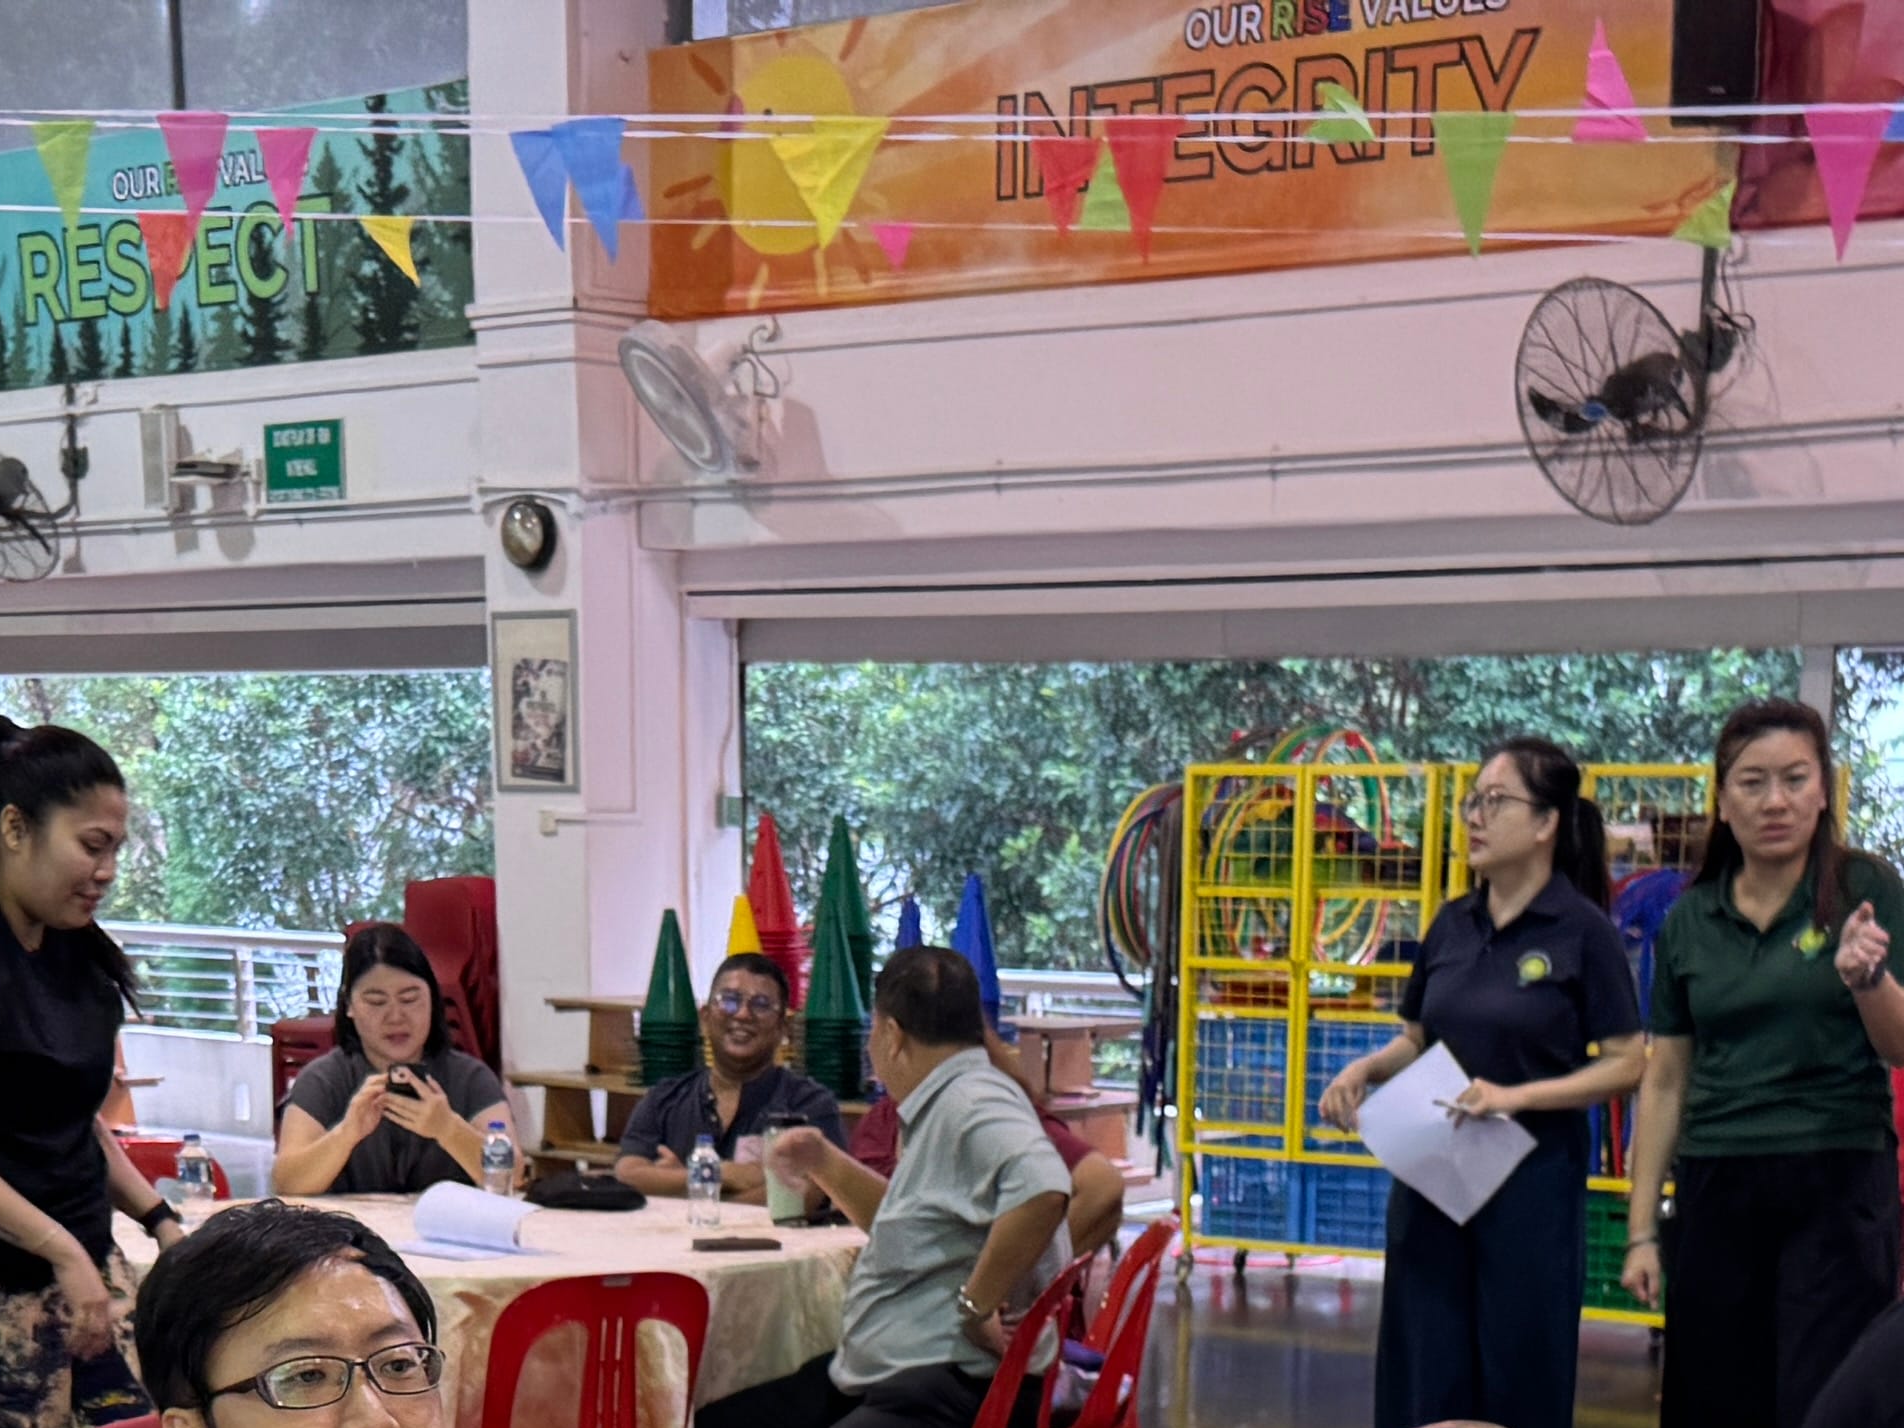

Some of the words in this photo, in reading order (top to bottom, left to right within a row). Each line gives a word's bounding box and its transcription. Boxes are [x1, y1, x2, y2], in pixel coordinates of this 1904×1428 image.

[1185, 1, 1264, 50] OUR
[1271, 0, 1352, 41] RISE
[997, 28, 1541, 200] INTEGRITY
[112, 164, 161, 201] OUR
[17, 193, 332, 326] RESECT
